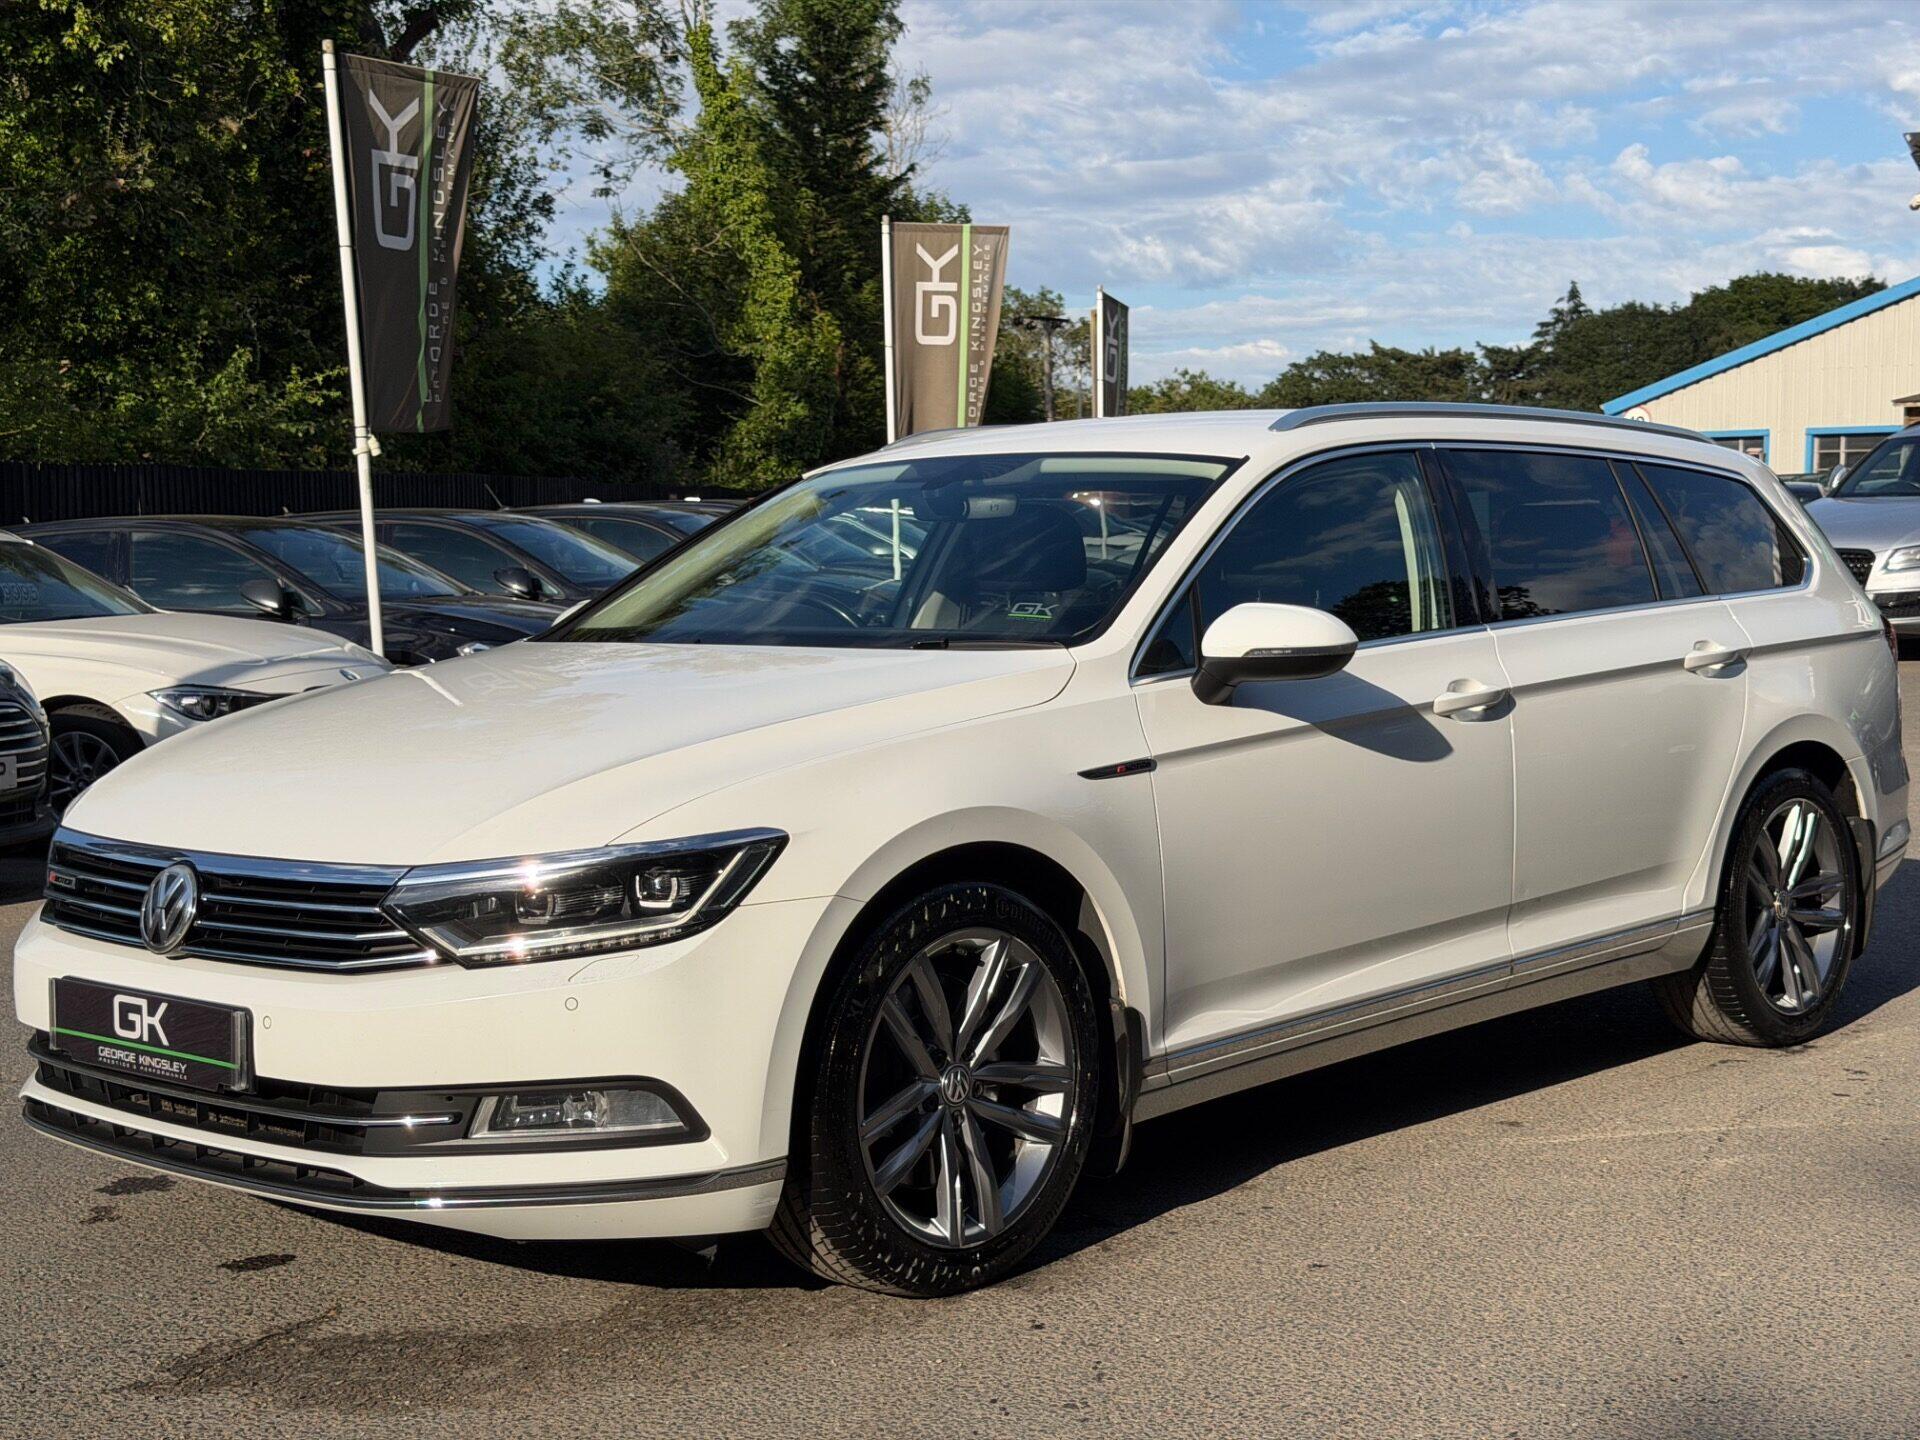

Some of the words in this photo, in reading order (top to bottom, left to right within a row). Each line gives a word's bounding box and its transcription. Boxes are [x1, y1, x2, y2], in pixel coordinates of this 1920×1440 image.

[369, 88, 420, 250] GK
[915, 242, 959, 345] GK
[971, 244, 984, 351] KINGSLEY
[1011, 602, 1059, 616] GK
[113, 994, 170, 1046] GK
[98, 1046, 136, 1063] GEORGE
[138, 1054, 187, 1074] KINGSLEY
